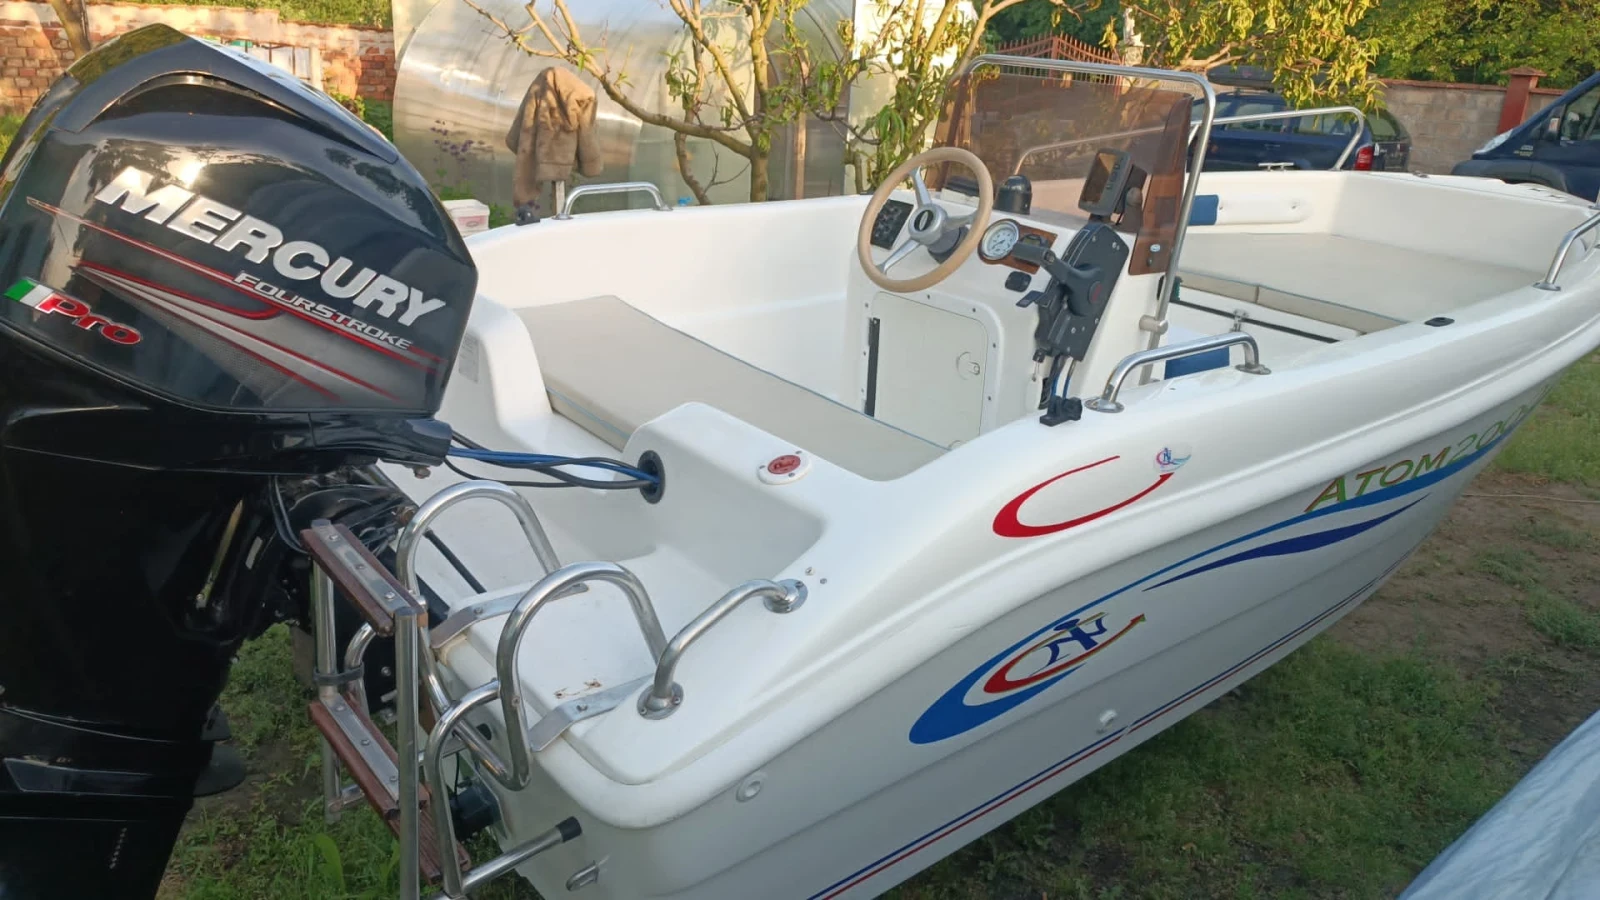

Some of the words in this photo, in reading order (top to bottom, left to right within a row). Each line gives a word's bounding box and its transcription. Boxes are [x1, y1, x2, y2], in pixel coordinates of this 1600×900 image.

[94, 165, 446, 326] MERCURY
[34, 291, 143, 344] Pro
[232, 271, 414, 350] FOURSTROKE
